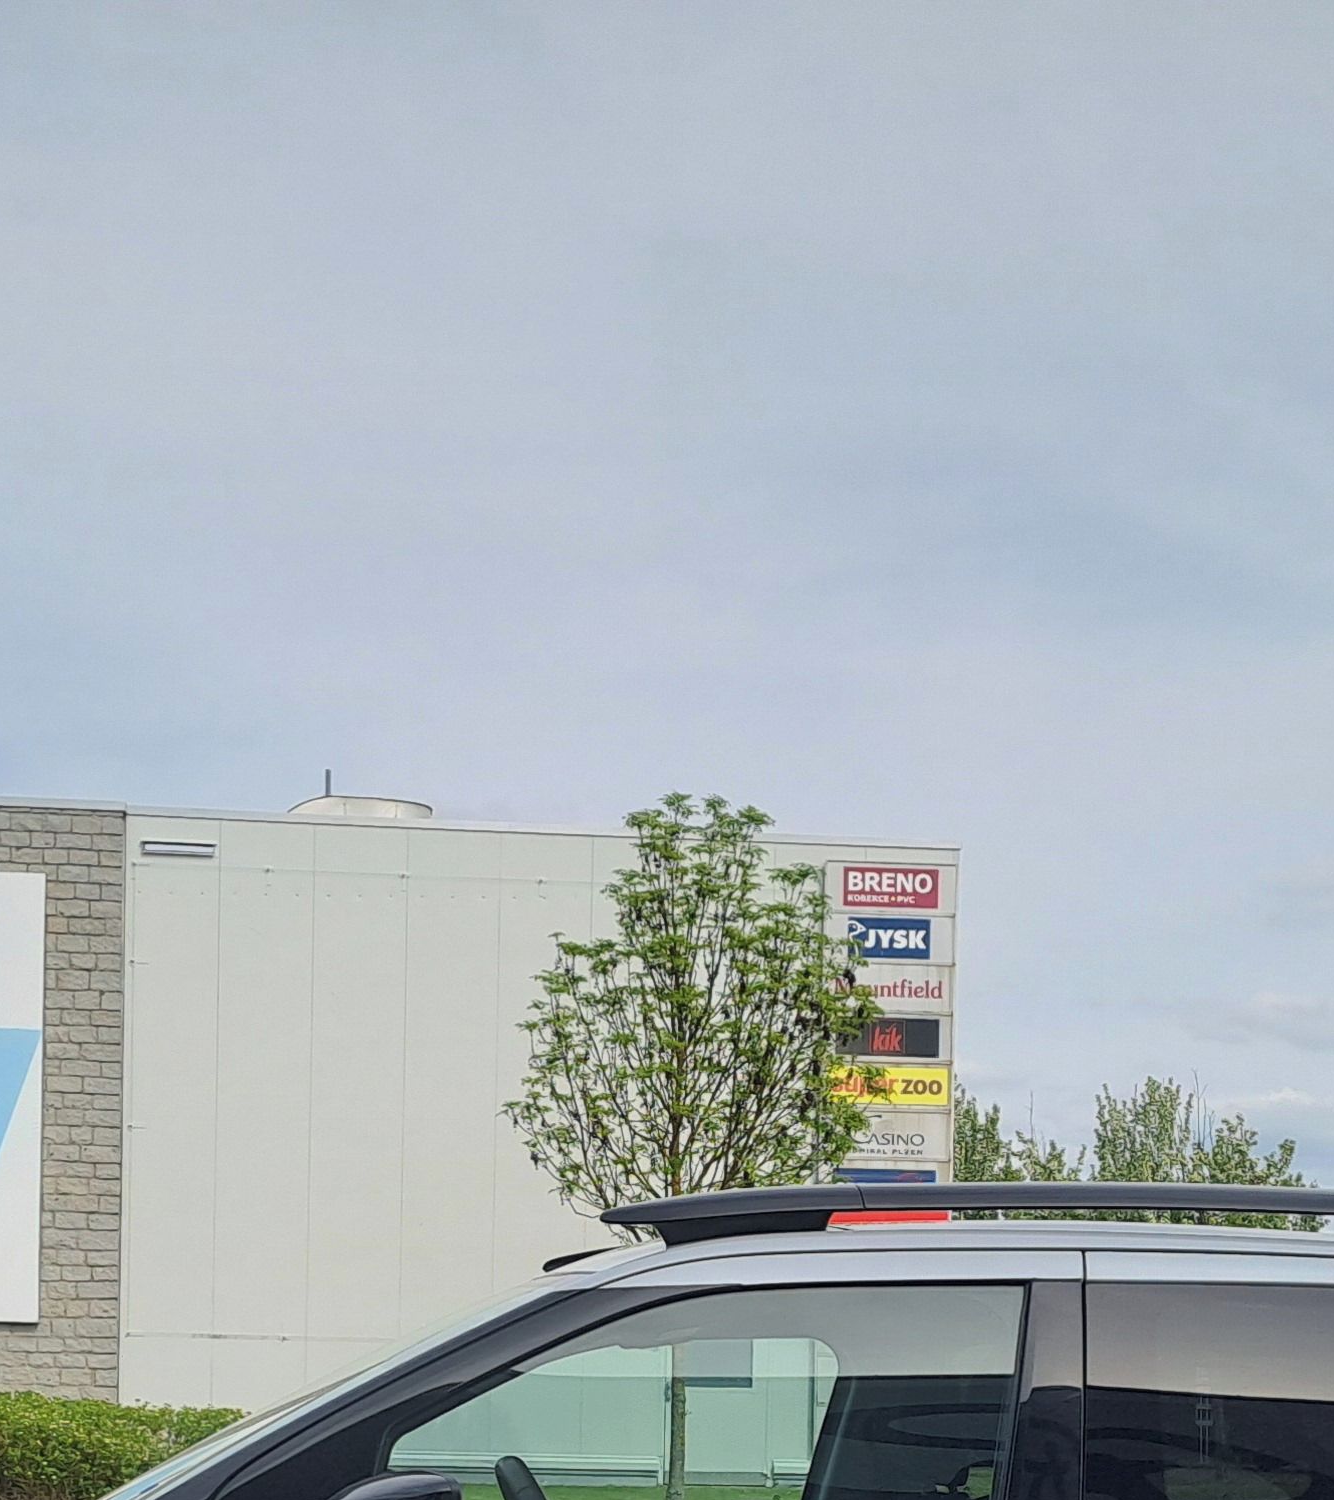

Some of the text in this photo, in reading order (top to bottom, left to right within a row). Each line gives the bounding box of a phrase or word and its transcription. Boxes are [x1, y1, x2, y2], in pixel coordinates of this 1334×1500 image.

[847, 871, 933, 894] BRENO
[847, 894, 916, 904] KOBERCE PVC
[864, 928, 927, 949] JYSK
[829, 978, 943, 999] Mntfield
